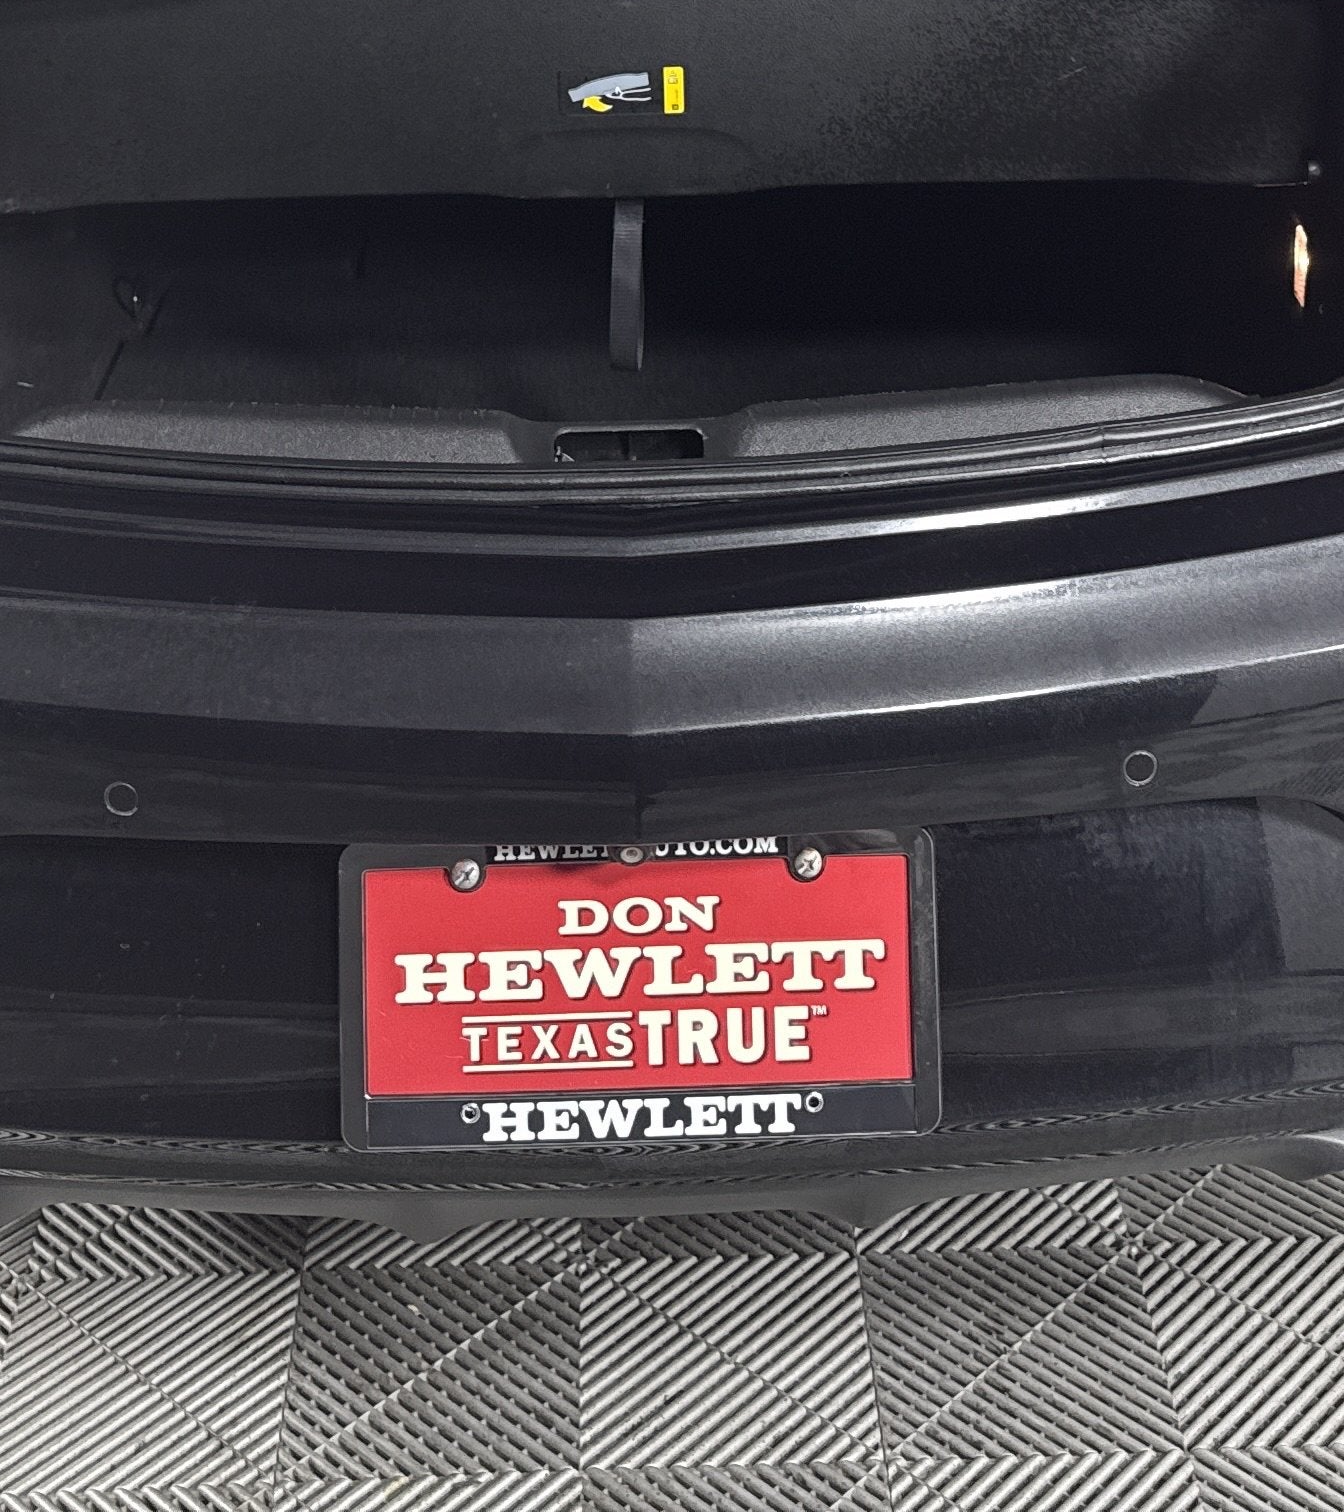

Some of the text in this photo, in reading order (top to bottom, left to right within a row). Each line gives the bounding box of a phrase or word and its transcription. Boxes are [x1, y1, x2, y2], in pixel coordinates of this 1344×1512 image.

[558, 895, 720, 935] DON
[395, 938, 884, 1004] HEWLETT
[483, 1093, 805, 1142] HEWLETT
